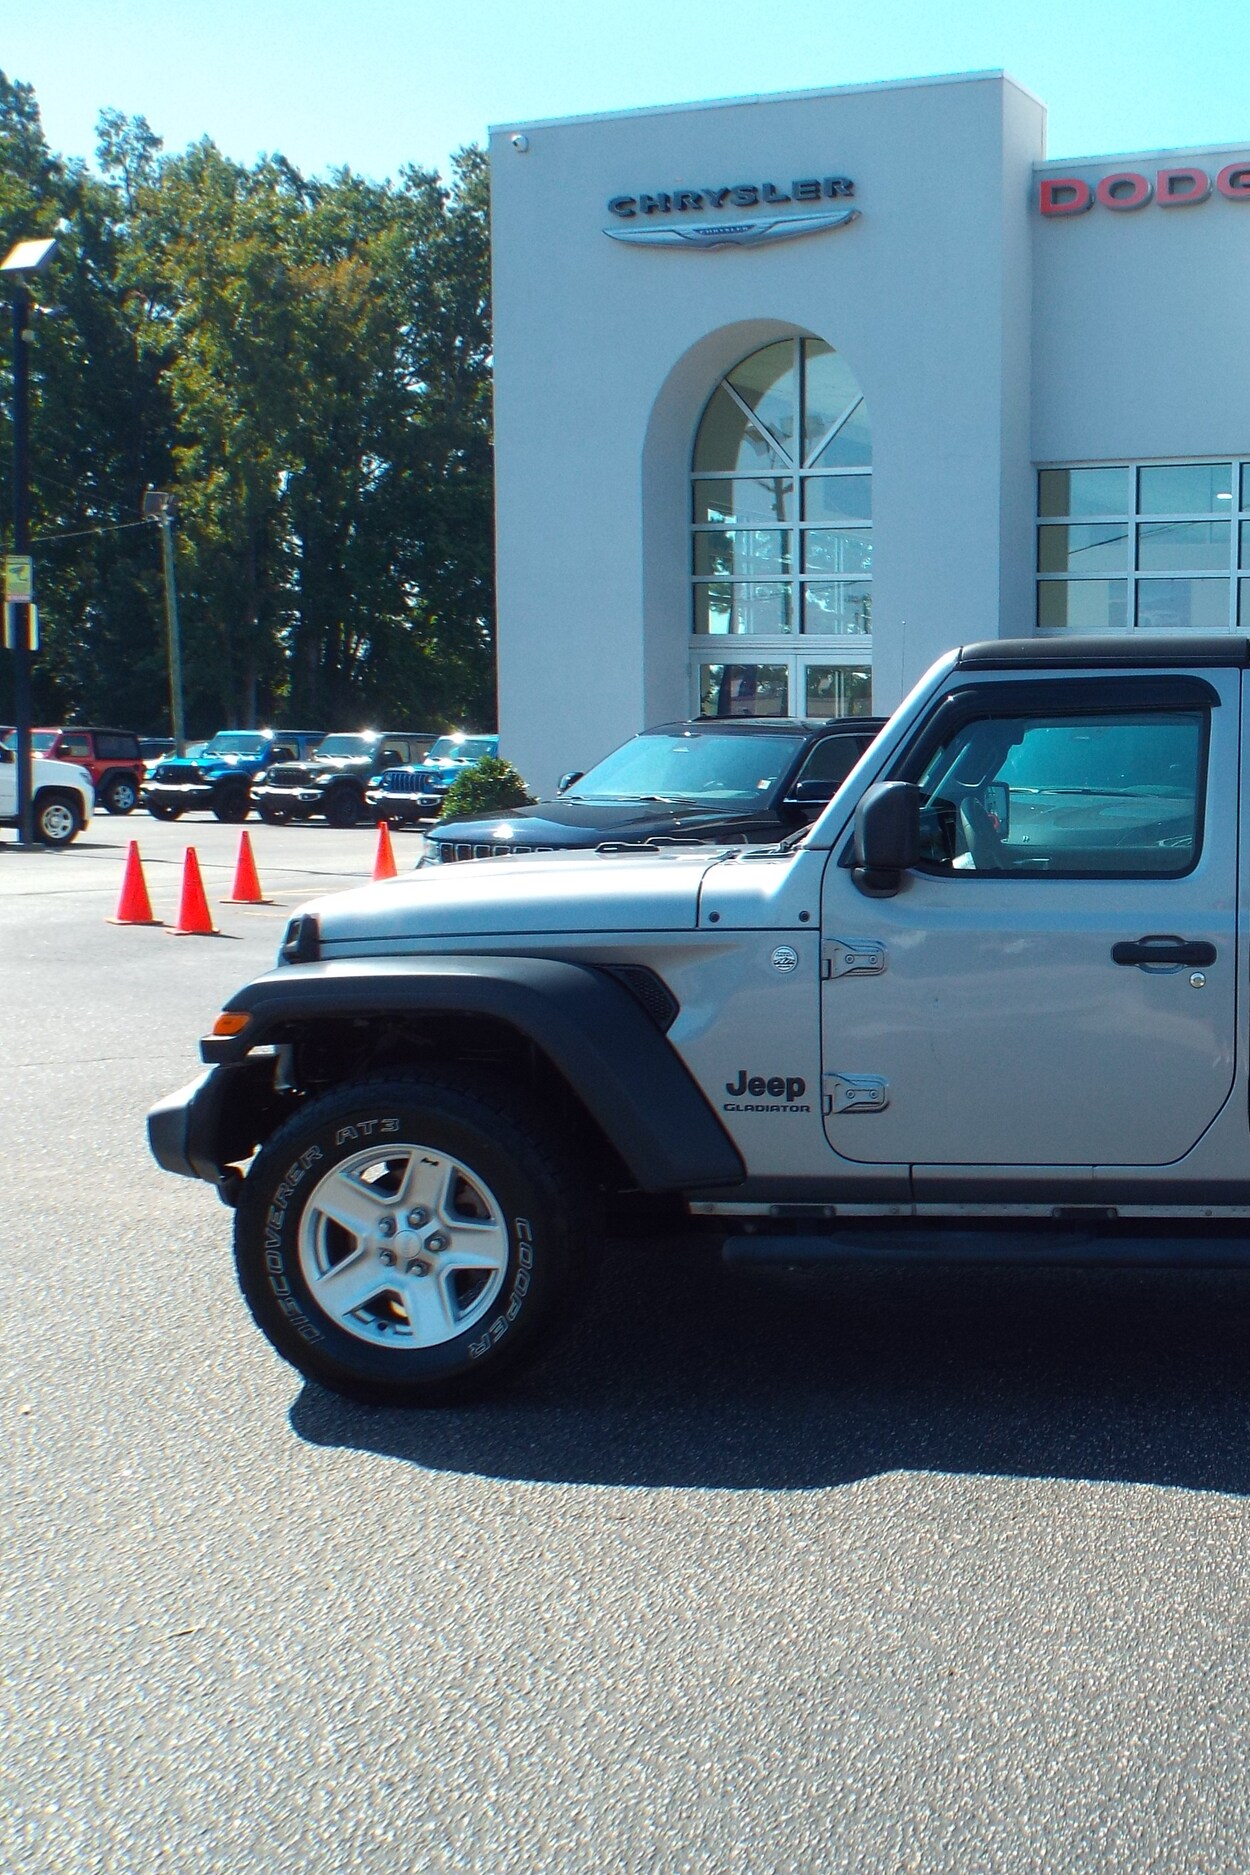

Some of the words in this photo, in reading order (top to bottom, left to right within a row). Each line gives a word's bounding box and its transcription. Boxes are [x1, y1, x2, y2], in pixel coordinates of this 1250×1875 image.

[607, 176, 855, 218] CHRYSLER
[726, 1069, 806, 1102] Jeep
[723, 1103, 811, 1113] GLADIATOR
[265, 1145, 325, 1345] DISCOVERER
[336, 1118, 400, 1145] AT3
[468, 1217, 534, 1359] COOPER
